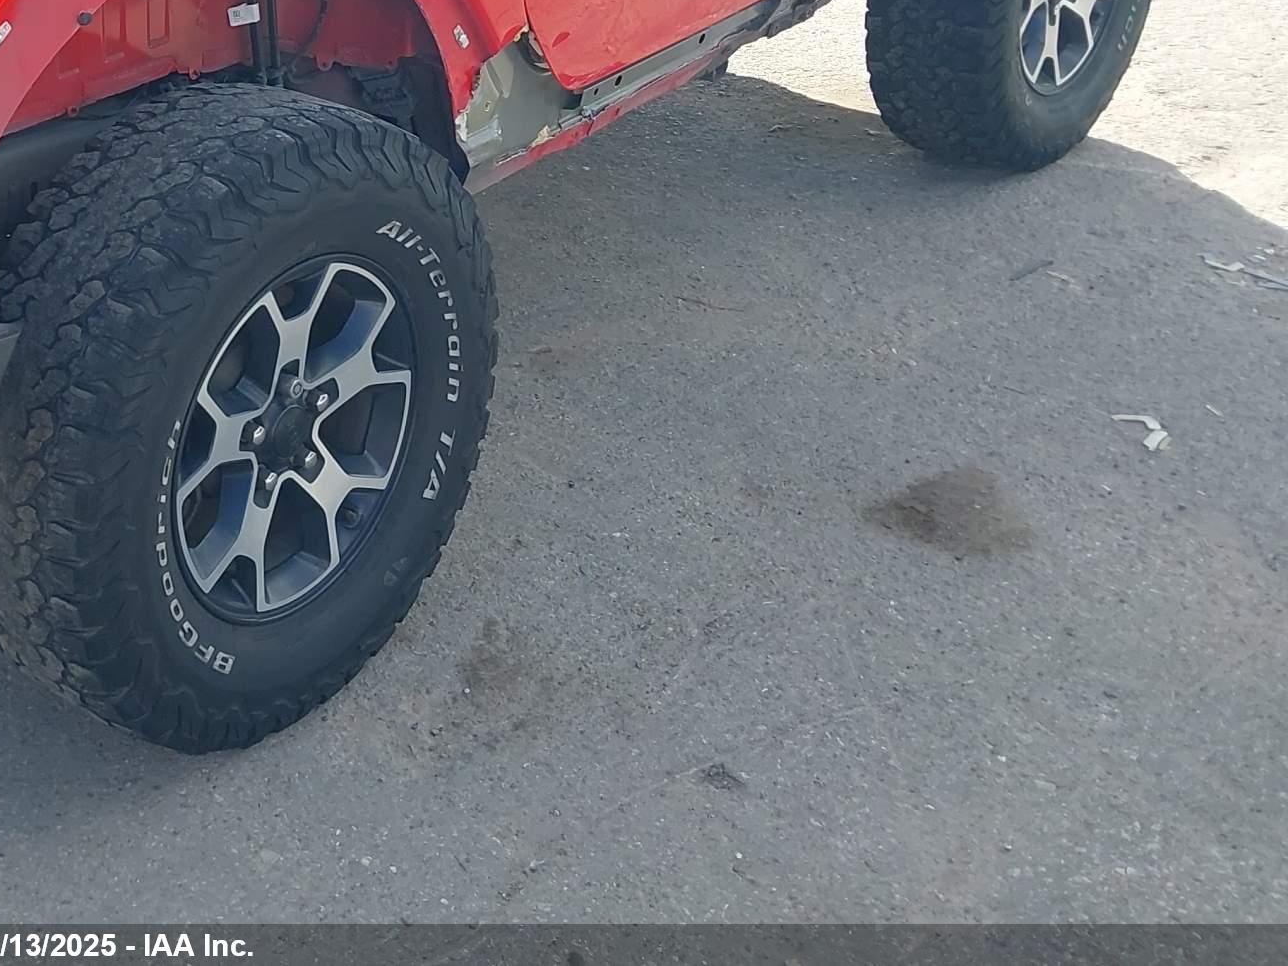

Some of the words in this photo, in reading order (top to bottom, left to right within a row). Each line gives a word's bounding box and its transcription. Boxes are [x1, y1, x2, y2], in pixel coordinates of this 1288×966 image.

[376, 220, 464, 402] All-Terrain
[422, 430, 455, 500] T/A
[156, 420, 236, 675] BFGoodrich
